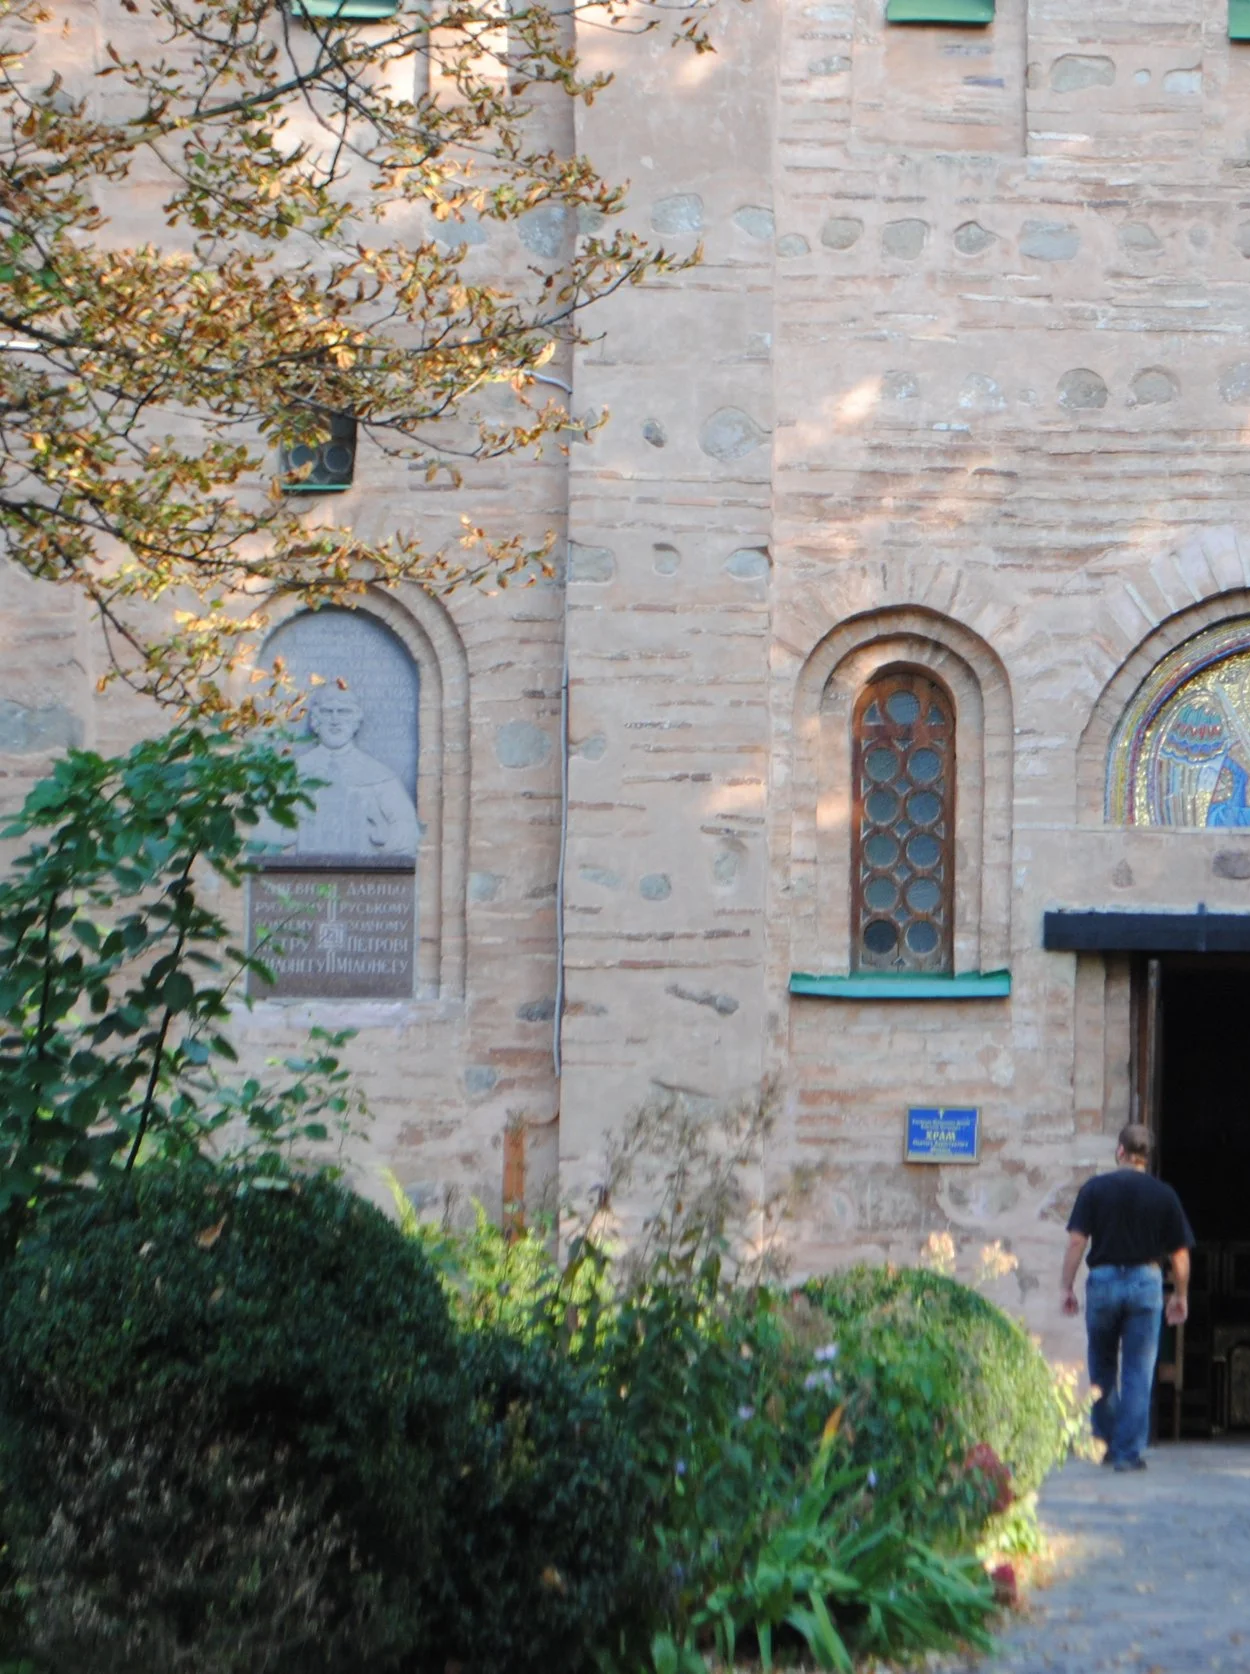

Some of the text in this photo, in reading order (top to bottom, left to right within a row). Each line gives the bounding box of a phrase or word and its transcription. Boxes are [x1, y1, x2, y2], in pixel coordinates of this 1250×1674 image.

[339, 902, 410, 914] РУСЬКОМУ
[347, 936, 408, 952] ПЕТРОВІ
[926, 1130, 955, 1141] ХРАМ
